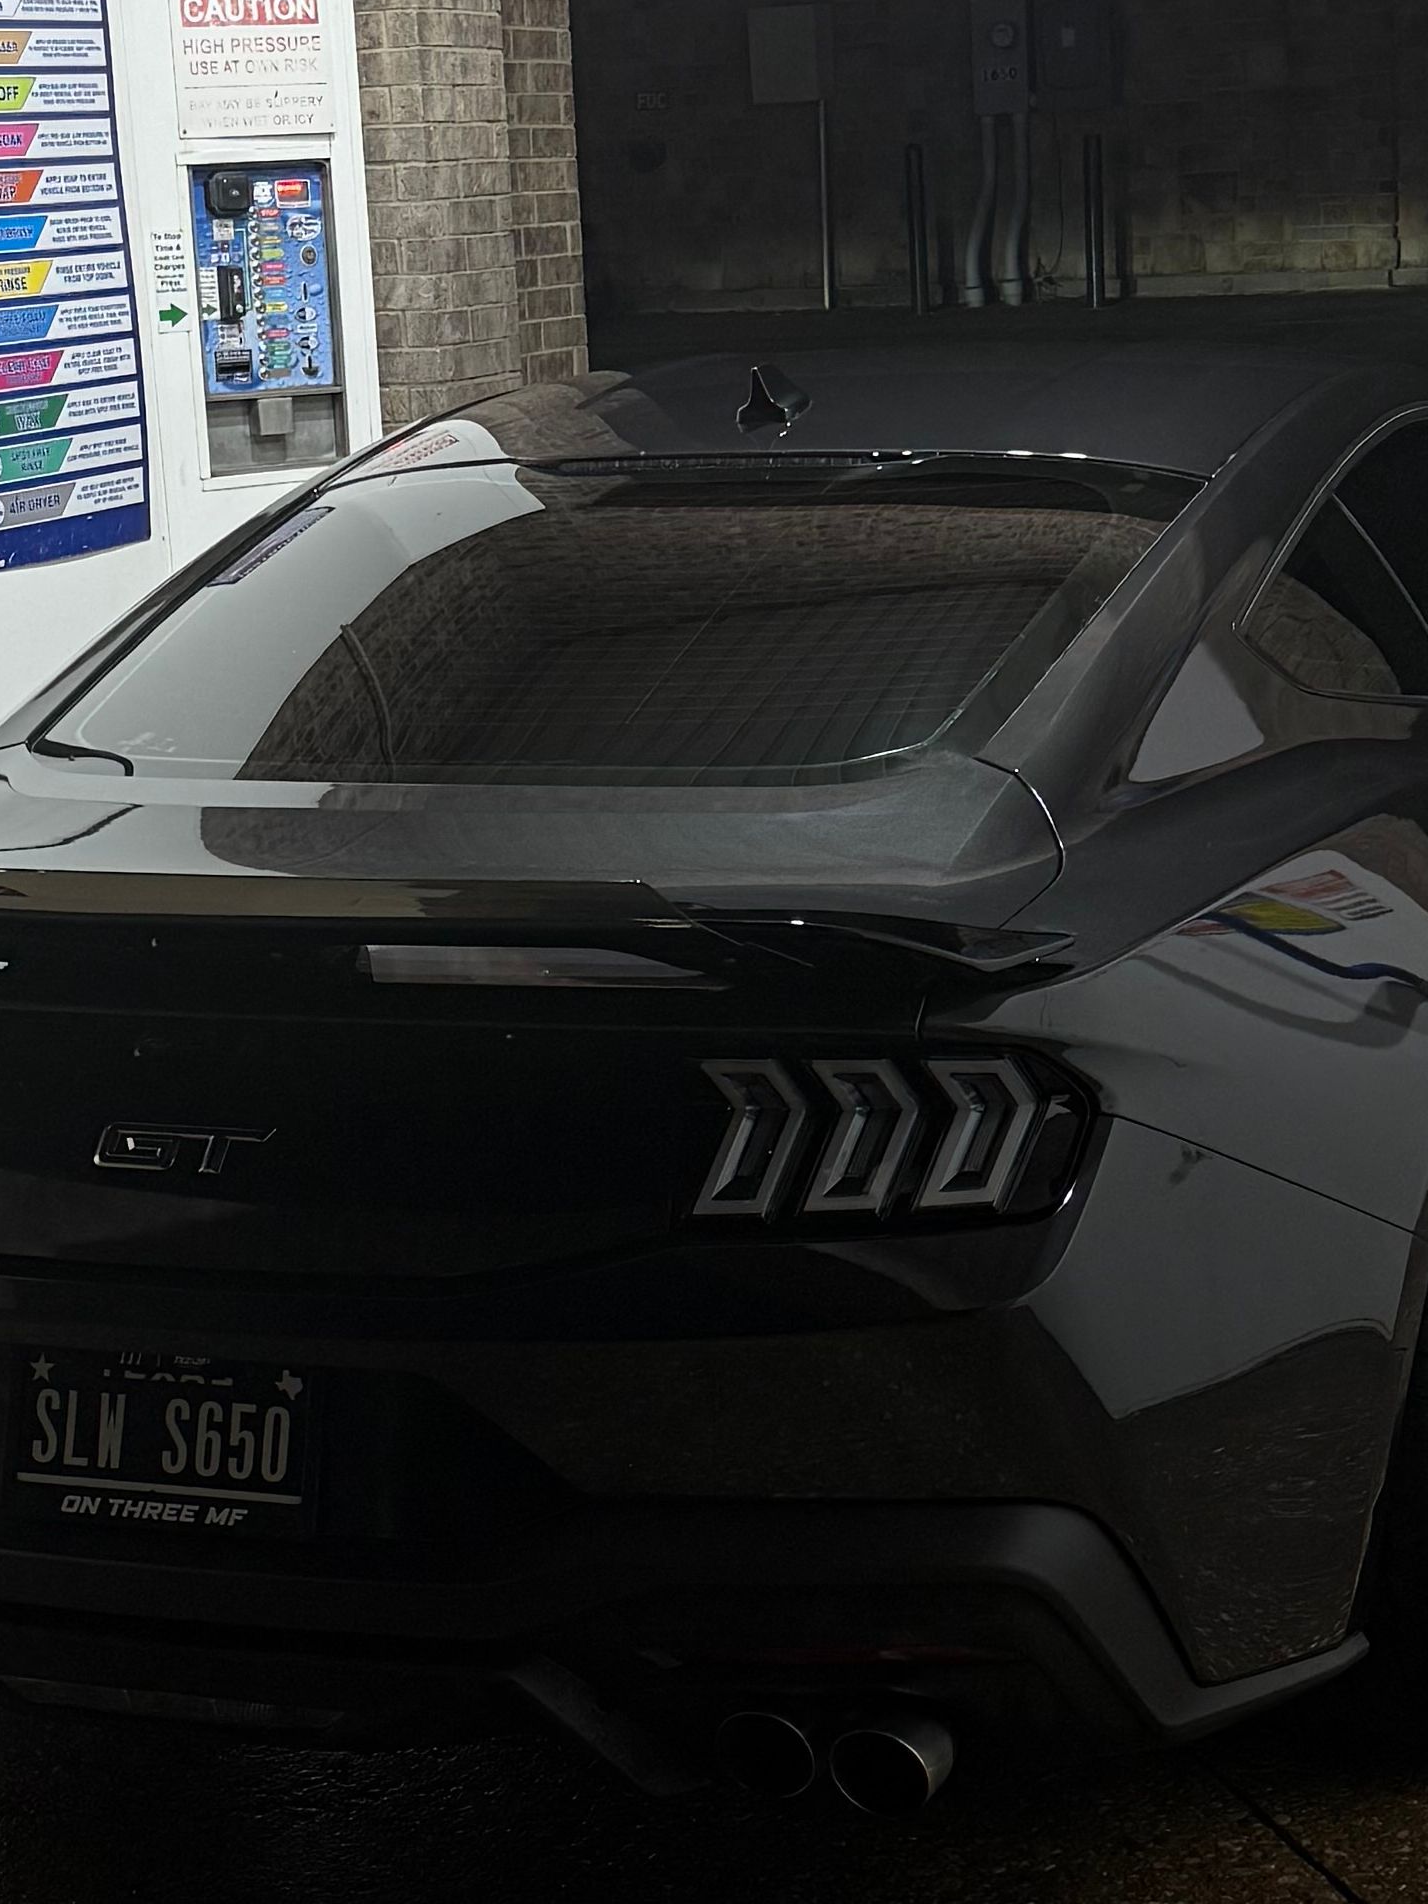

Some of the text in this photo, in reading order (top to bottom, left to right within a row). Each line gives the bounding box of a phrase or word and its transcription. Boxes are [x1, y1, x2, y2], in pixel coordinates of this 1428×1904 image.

[183, 36, 321, 55] HIGH PRESSURE
[190, 61, 218, 75] USE
[224, 60, 239, 73] AT
[93, 1122, 277, 1174] GT
[32, 1388, 291, 1483] SLW S650
[61, 1495, 248, 1526] ON THREE MF
